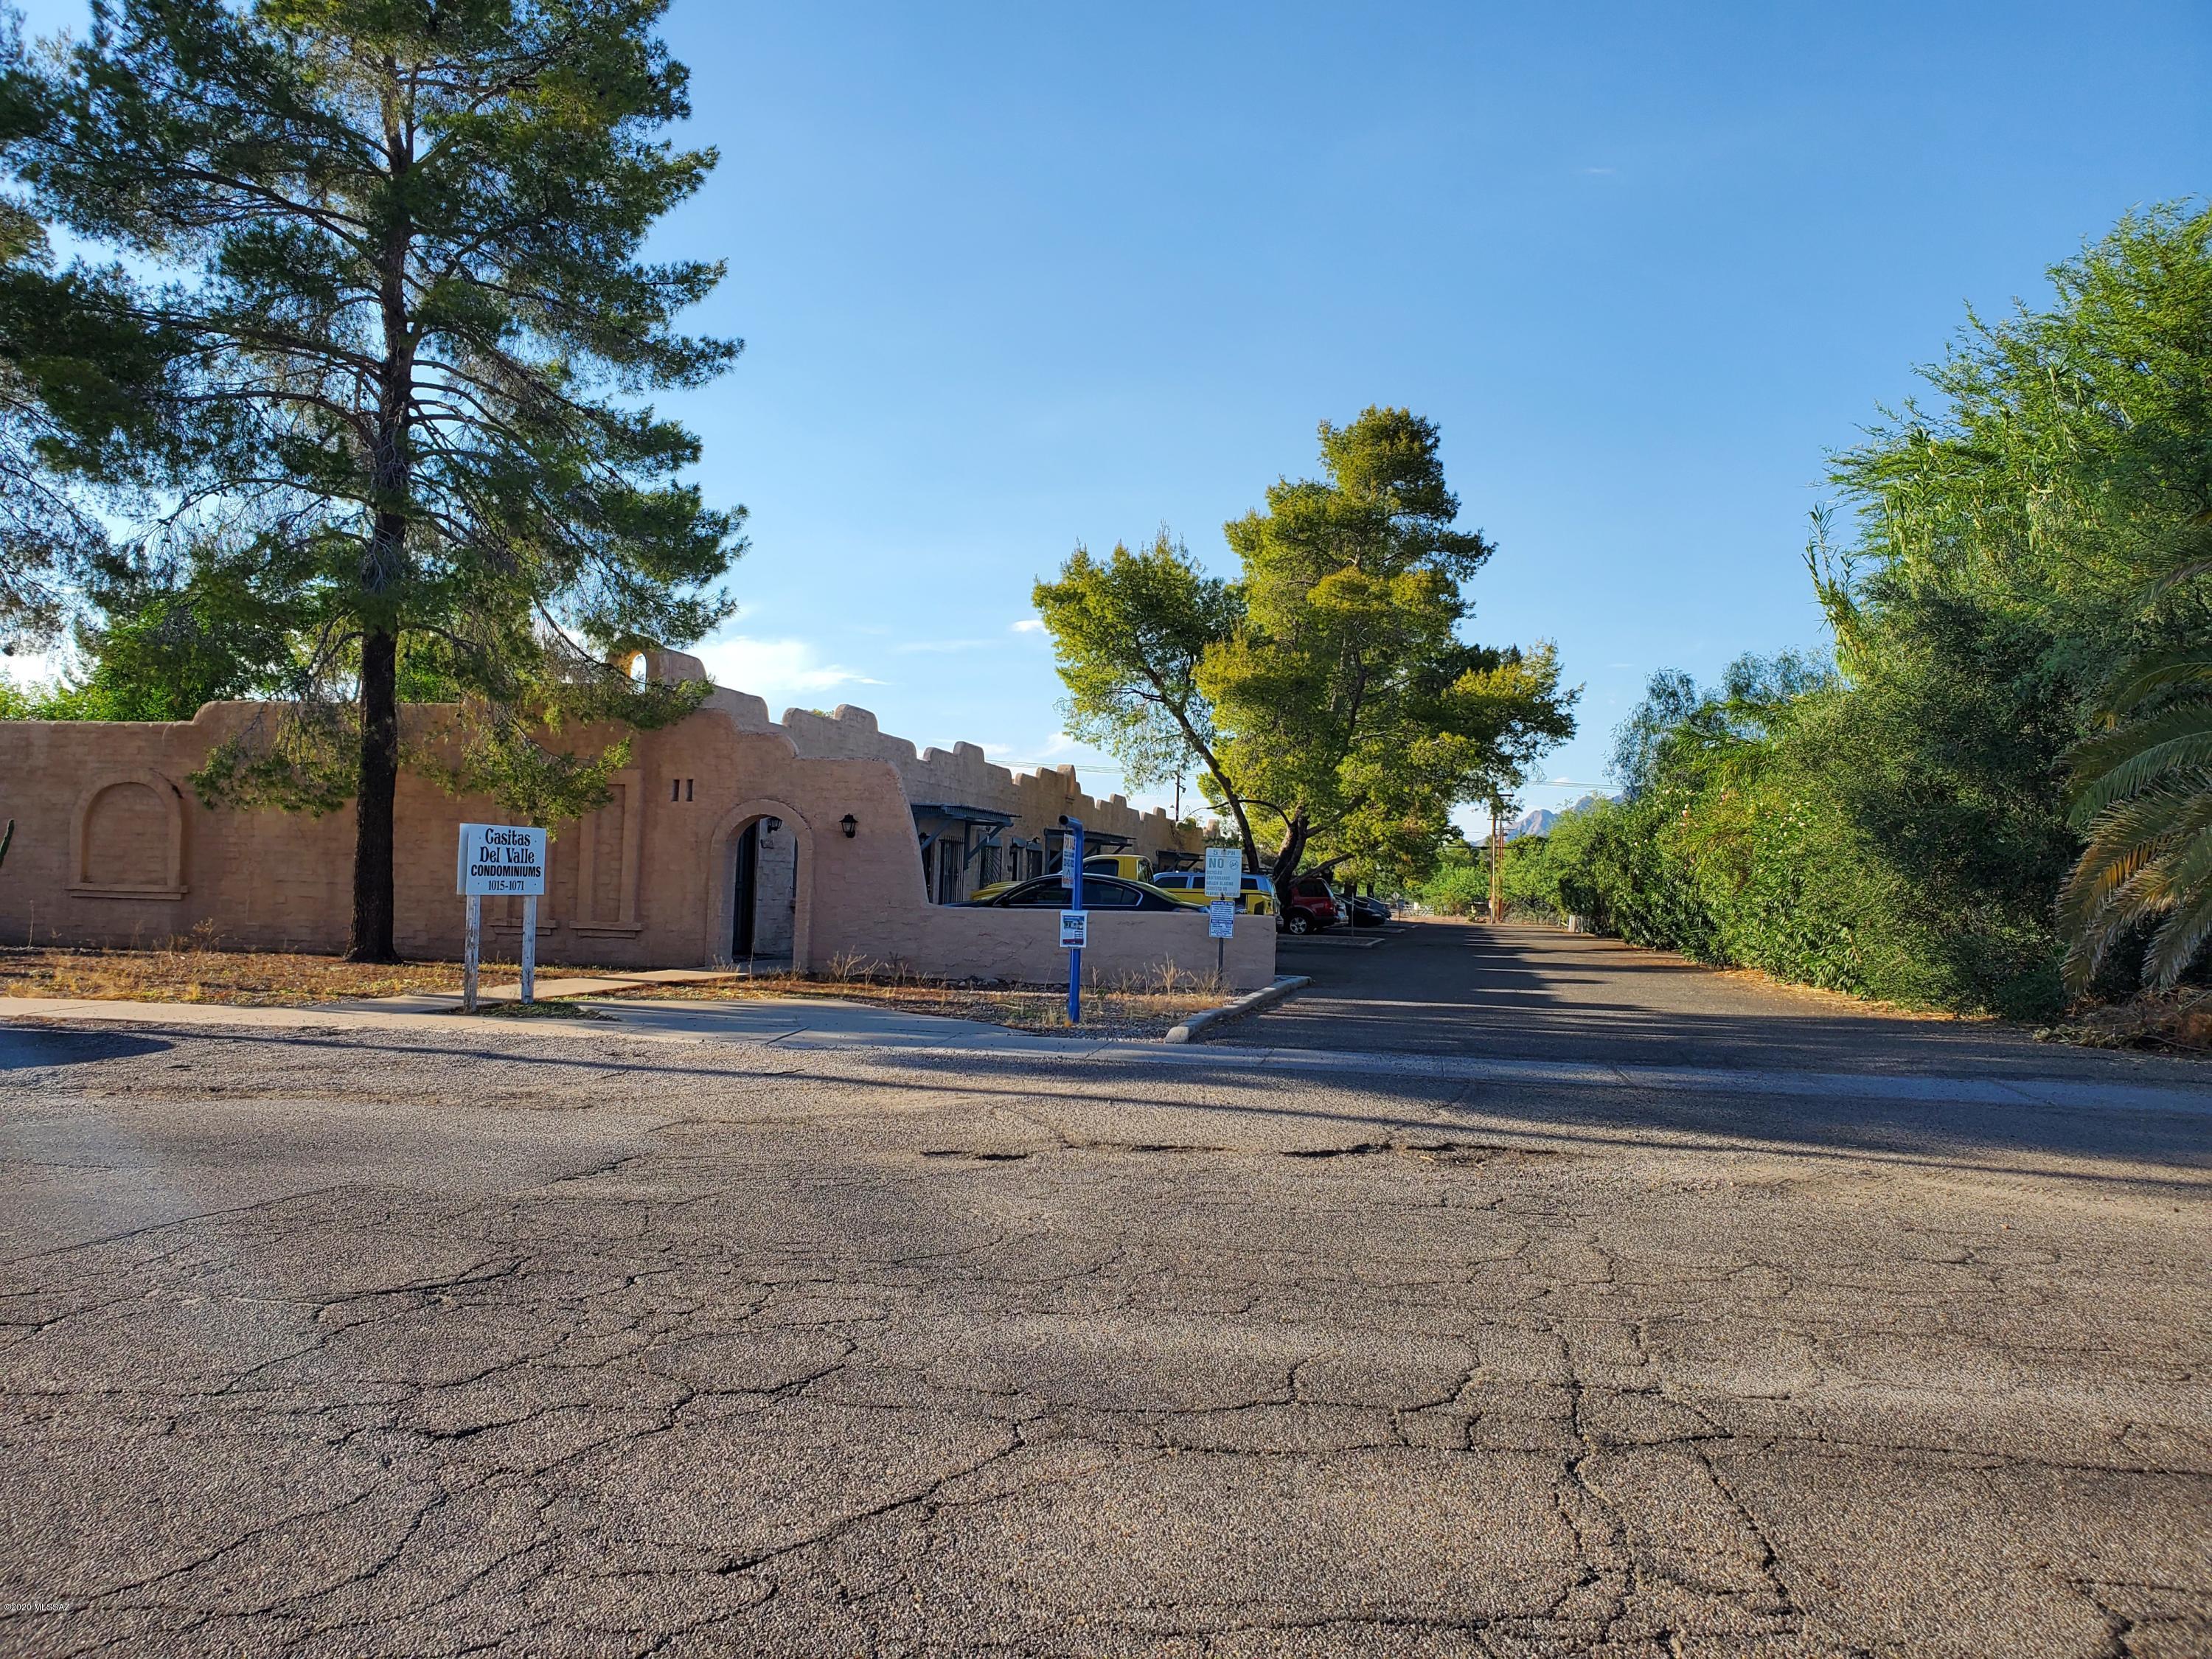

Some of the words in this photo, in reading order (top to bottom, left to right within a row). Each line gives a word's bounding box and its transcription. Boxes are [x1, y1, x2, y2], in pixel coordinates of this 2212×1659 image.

[485, 828, 531, 846] Casitas
[479, 846, 501, 863] Del
[506, 846, 535, 864] Valle
[1208, 858, 1224, 868] NO
[470, 864, 541, 877] CONDOMINIUMS
[488, 880, 524, 891] 1015-1071
